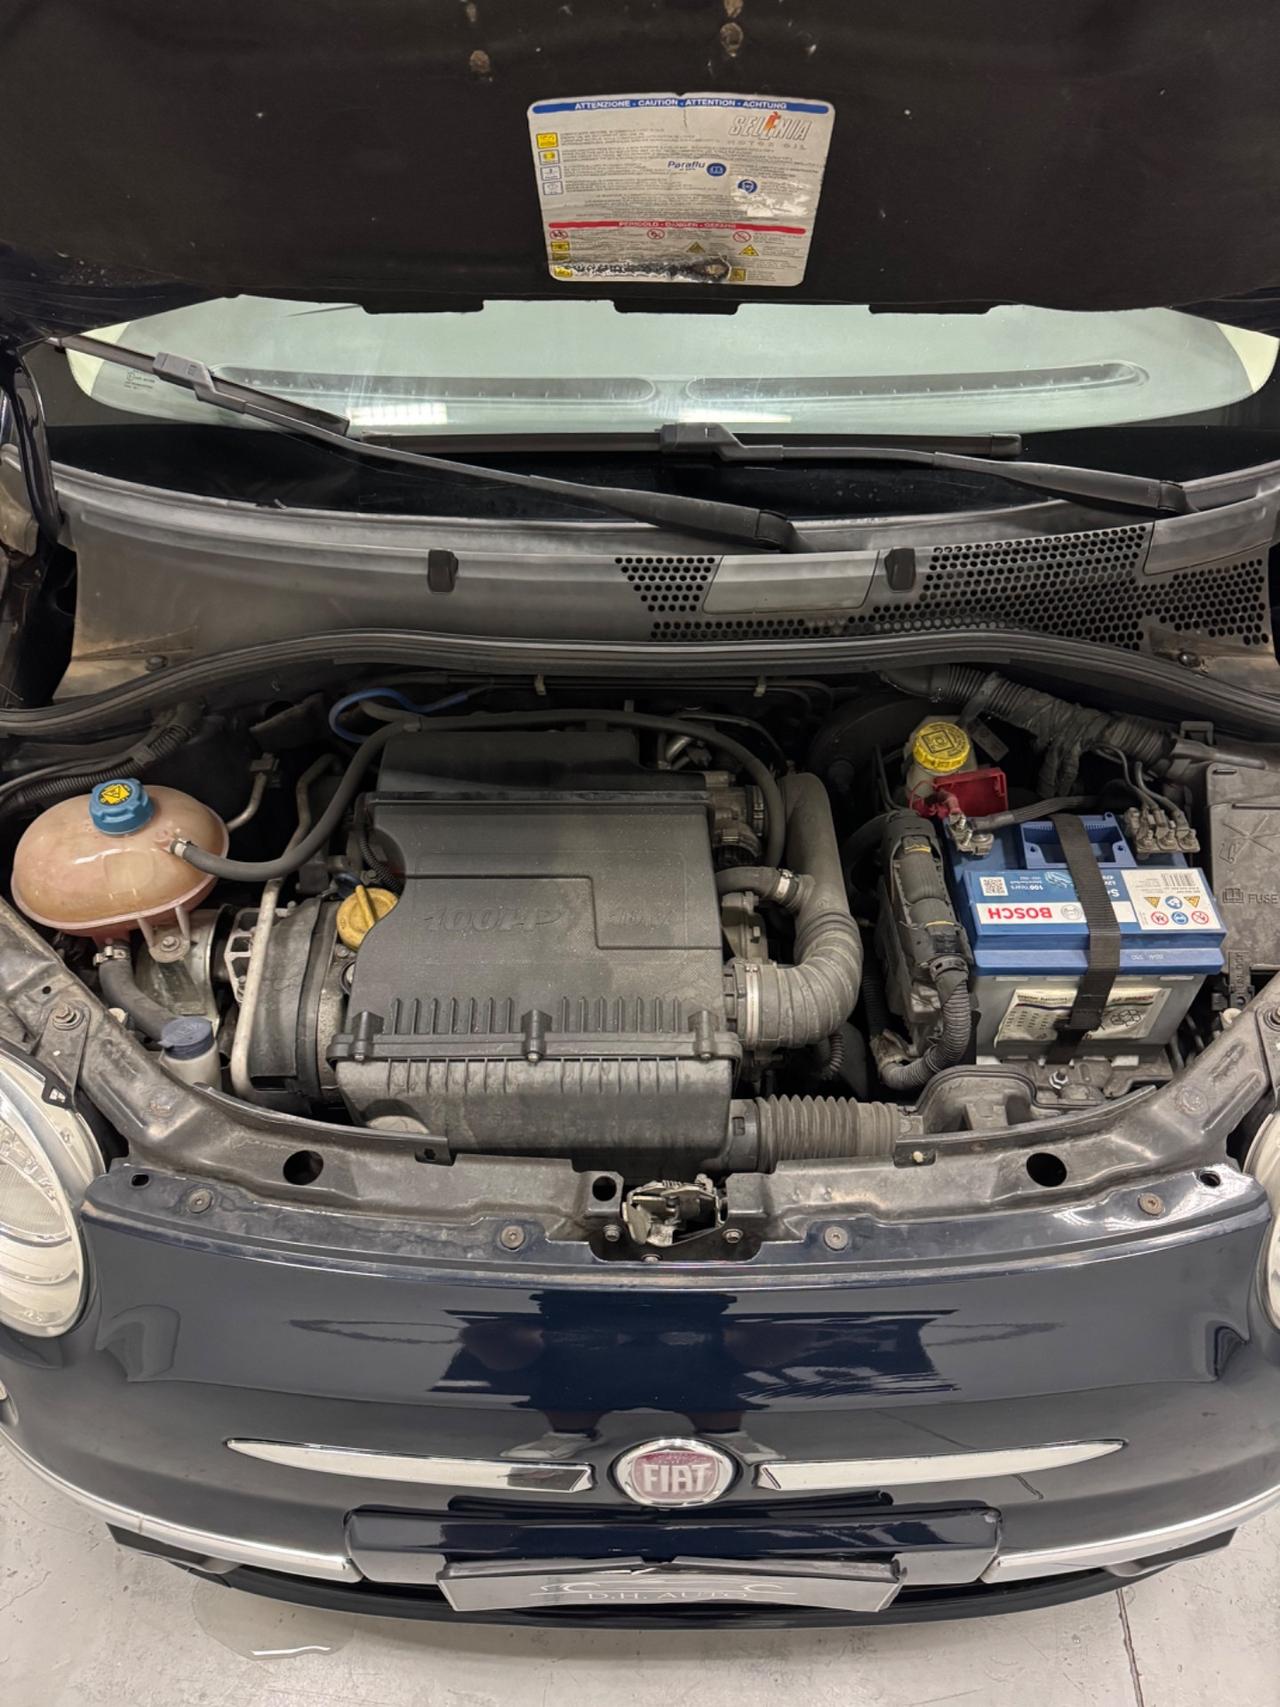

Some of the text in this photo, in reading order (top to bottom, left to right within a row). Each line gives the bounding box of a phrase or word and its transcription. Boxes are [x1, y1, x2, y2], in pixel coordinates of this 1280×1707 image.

[574, 98, 788, 110] ATTENZIONE CAUTION ATTENTION ACHTUNG
[728, 112, 812, 141] SELENIA
[667, 160, 706, 169] Paraflu
[1247, 893, 1279, 904] FUSE
[987, 906, 1053, 920] BOSCH
[643, 1464, 711, 1493] FIAT
